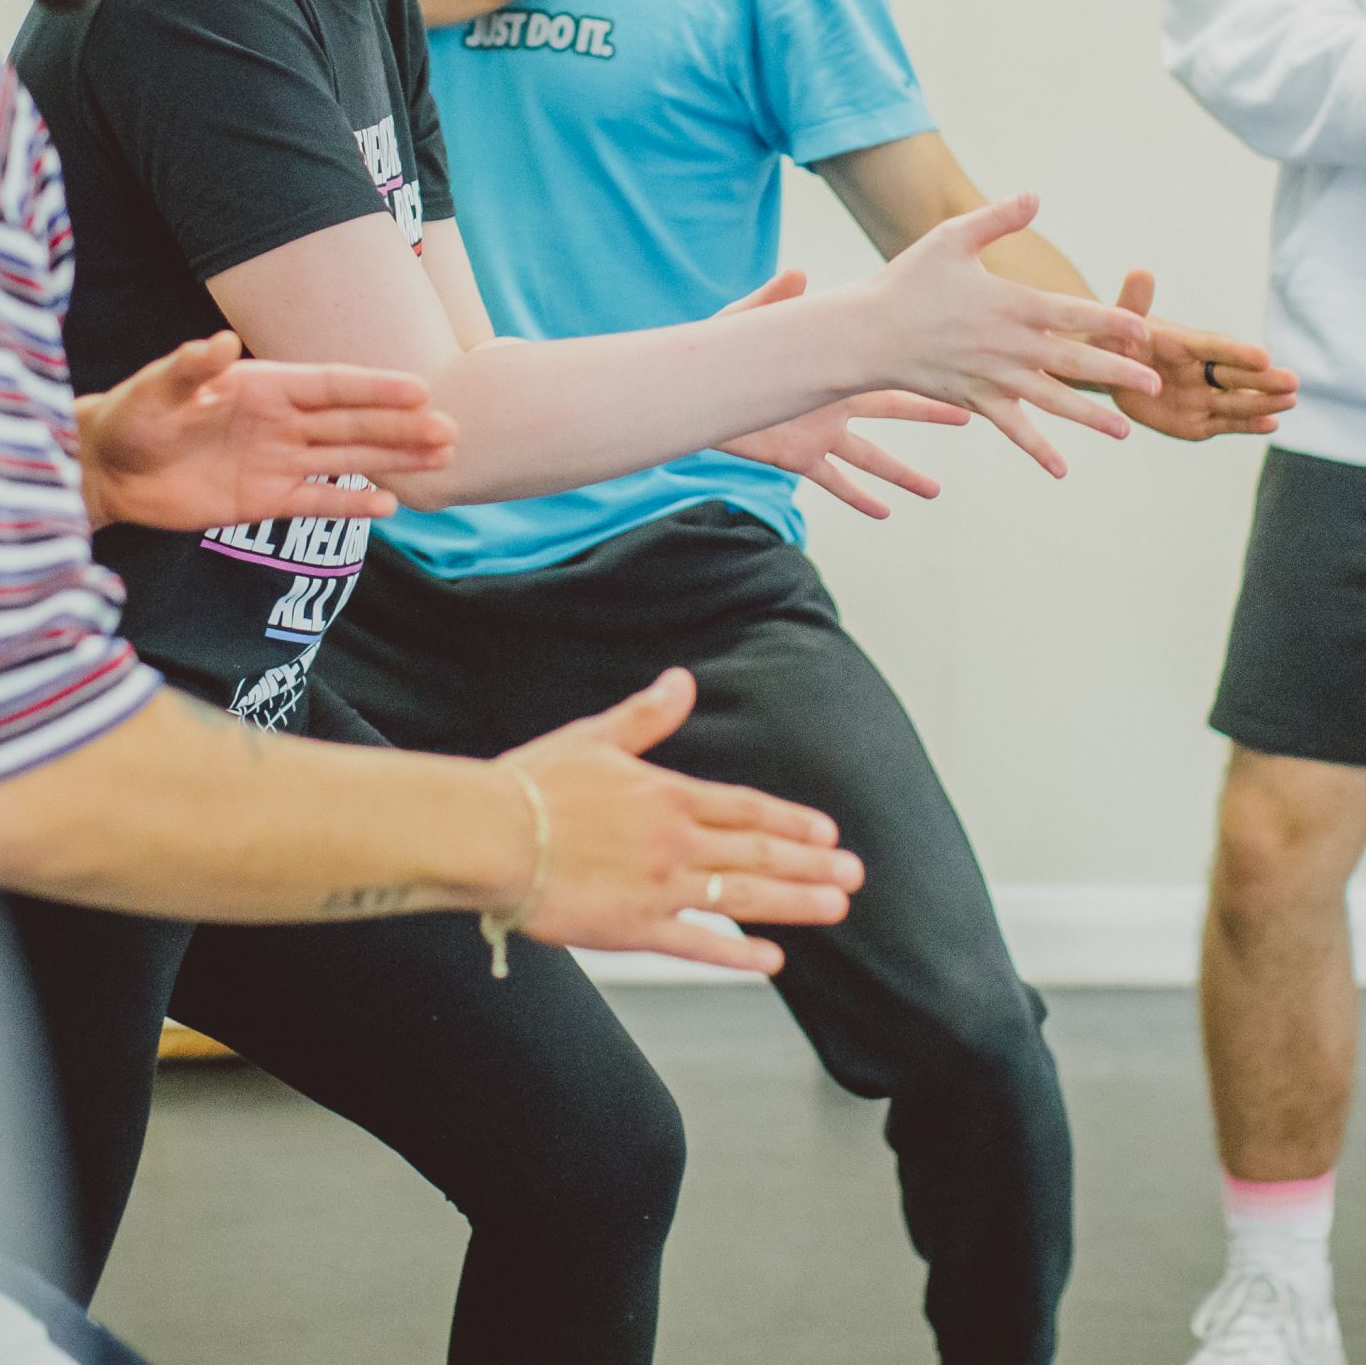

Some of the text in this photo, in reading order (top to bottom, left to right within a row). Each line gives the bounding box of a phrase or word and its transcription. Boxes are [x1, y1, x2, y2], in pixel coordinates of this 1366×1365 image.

[464, 11, 528, 50] JUST
[524, 11, 576, 51] DO
[268, 574, 337, 632] ALL
